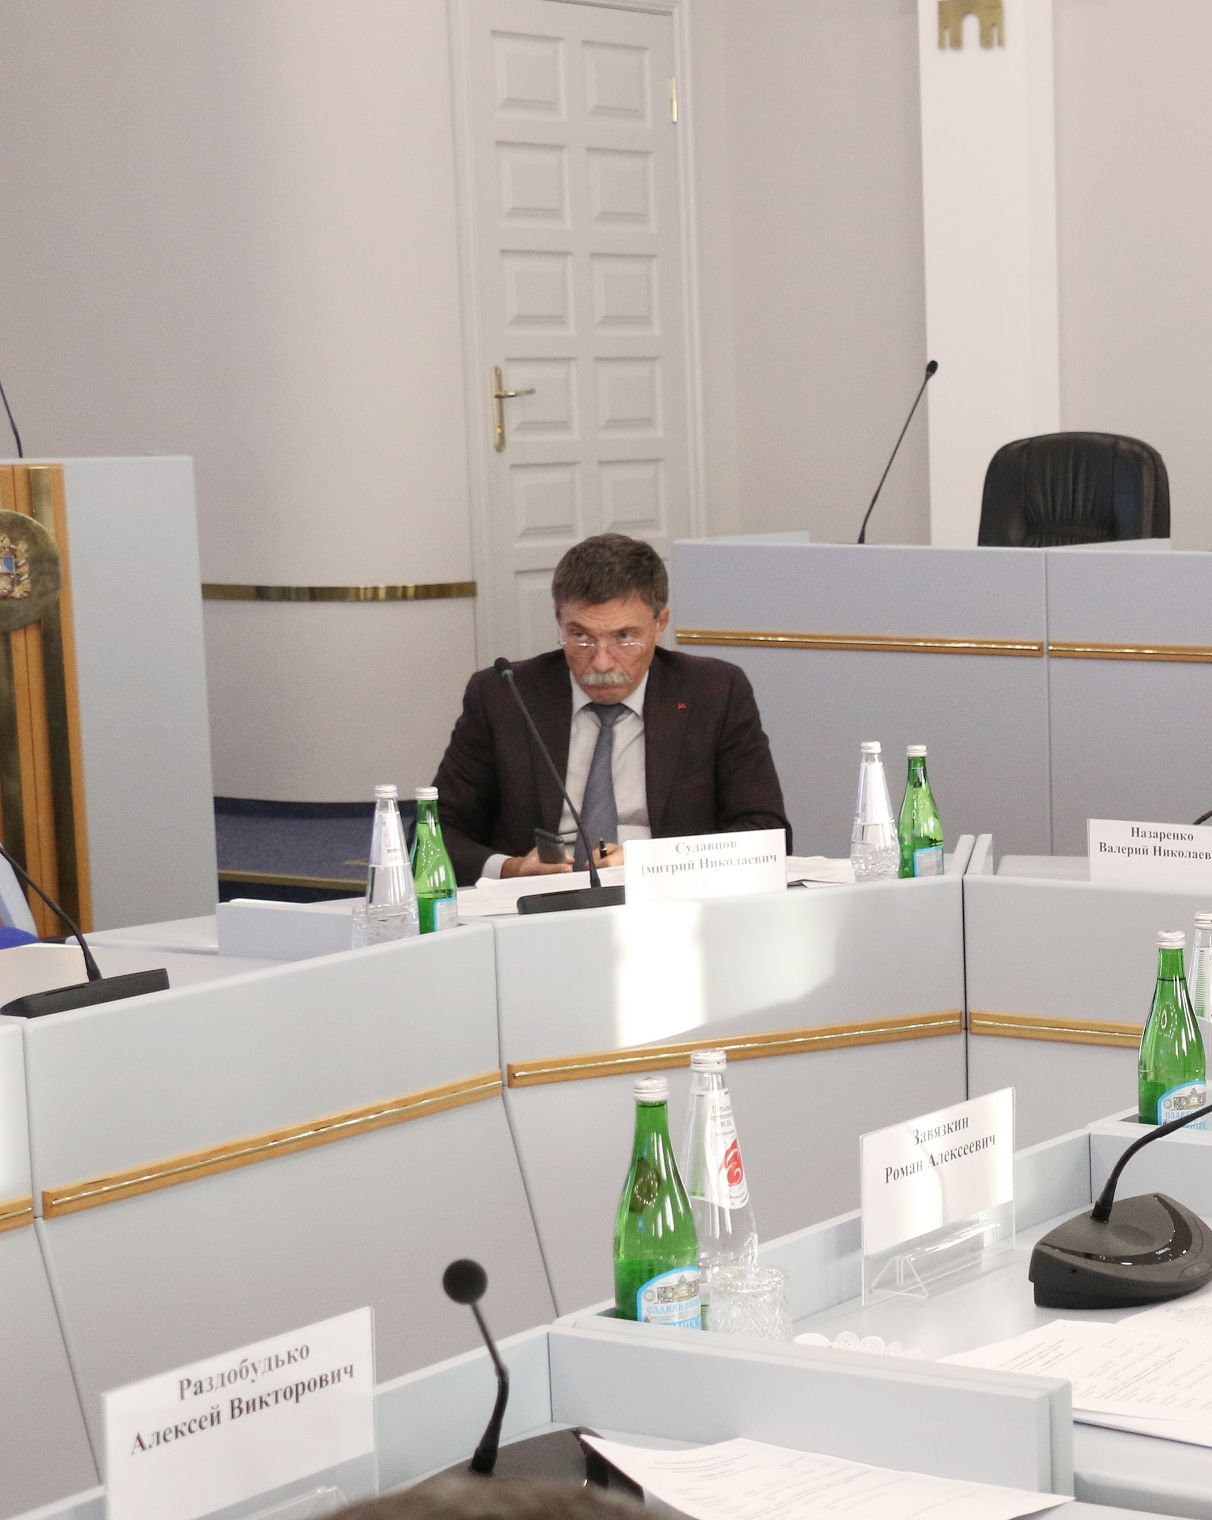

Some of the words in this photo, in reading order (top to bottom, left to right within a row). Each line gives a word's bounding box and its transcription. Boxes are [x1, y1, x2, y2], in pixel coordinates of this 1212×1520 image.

[1131, 826, 1194, 842] Назаренко
[700, 853, 777, 870] Николаевич
[1099, 842, 1149, 857] Валерий
[912, 1116, 969, 1146] Завязкин
[885, 1159, 923, 1184] Роман
[927, 1134, 996, 1168] Алексеевич
[178, 1343, 310, 1401] Раздобудько
[130, 1405, 222, 1456] Алексей
[229, 1363, 355, 1421] Викторович
